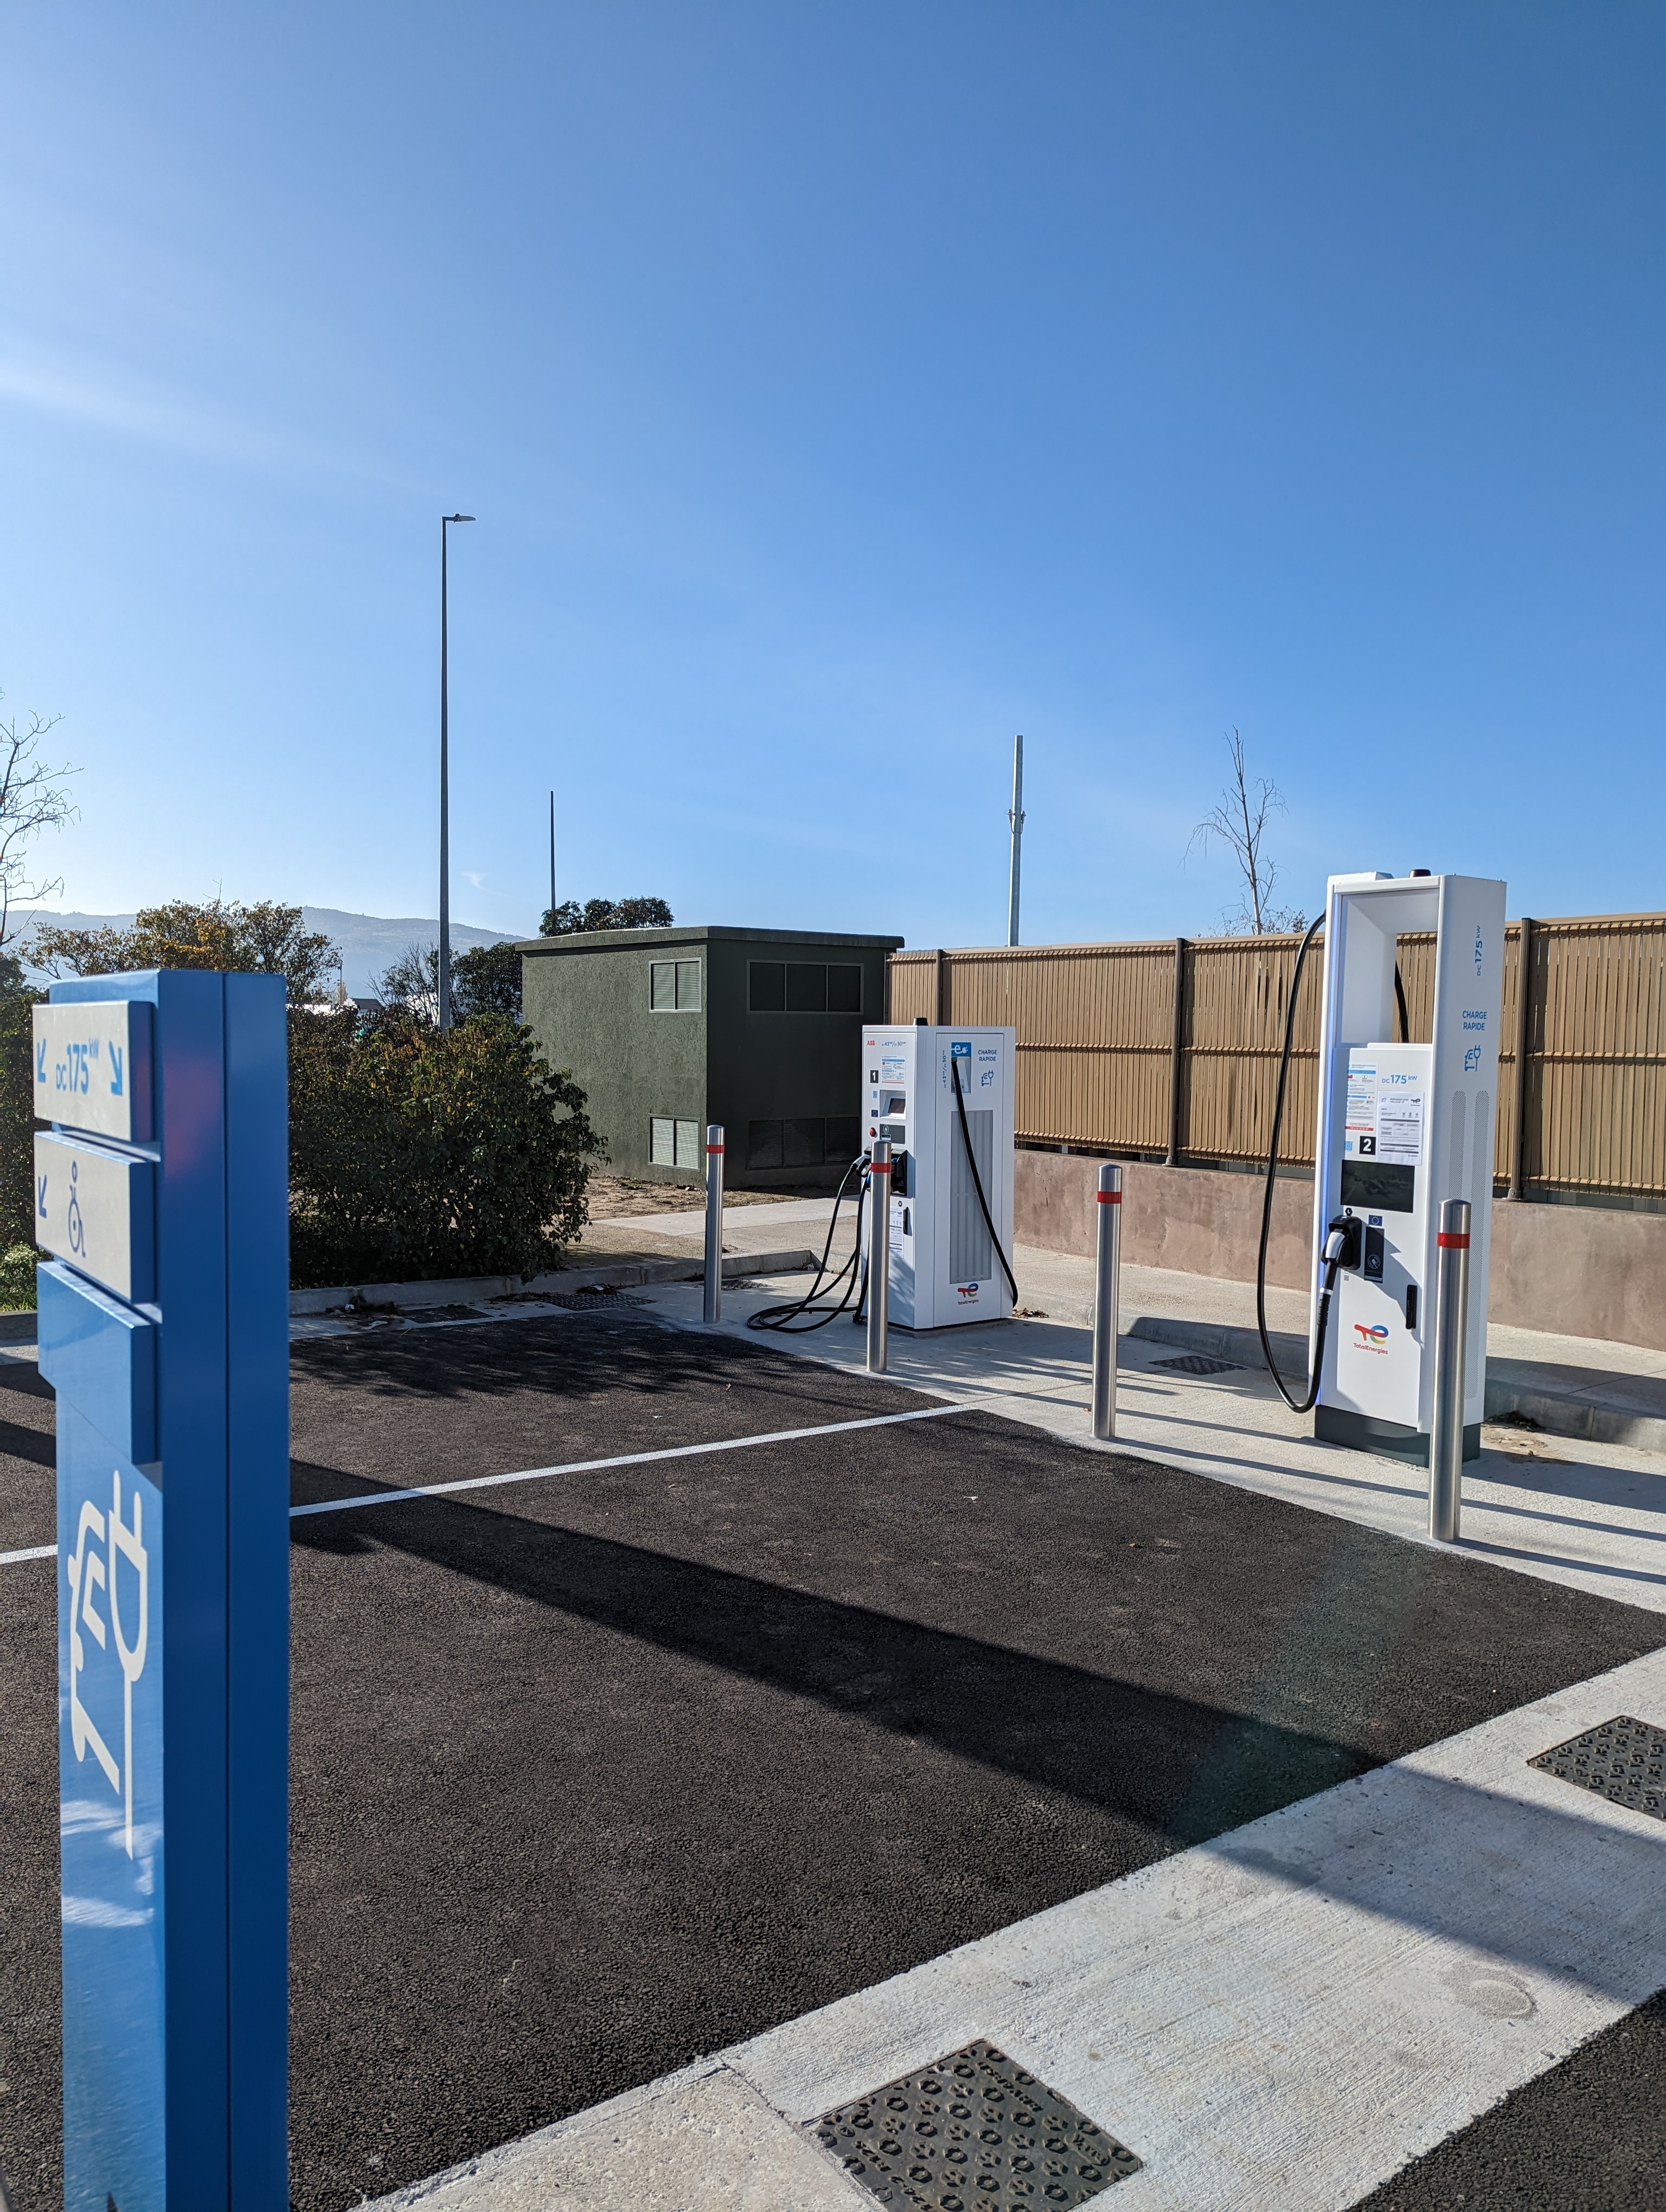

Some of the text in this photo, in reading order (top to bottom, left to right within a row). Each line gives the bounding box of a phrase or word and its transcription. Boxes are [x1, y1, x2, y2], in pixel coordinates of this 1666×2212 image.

[1462, 1011, 1488, 1020] CHARGE
[1463, 1023, 1485, 1031] RAPIDE
[872, 1071, 876, 1081] 1
[1391, 1075, 1407, 1084] 175
[1362, 1138, 1372, 1152] 2
[1353, 1342, 1388, 1355] TotalEnergies
